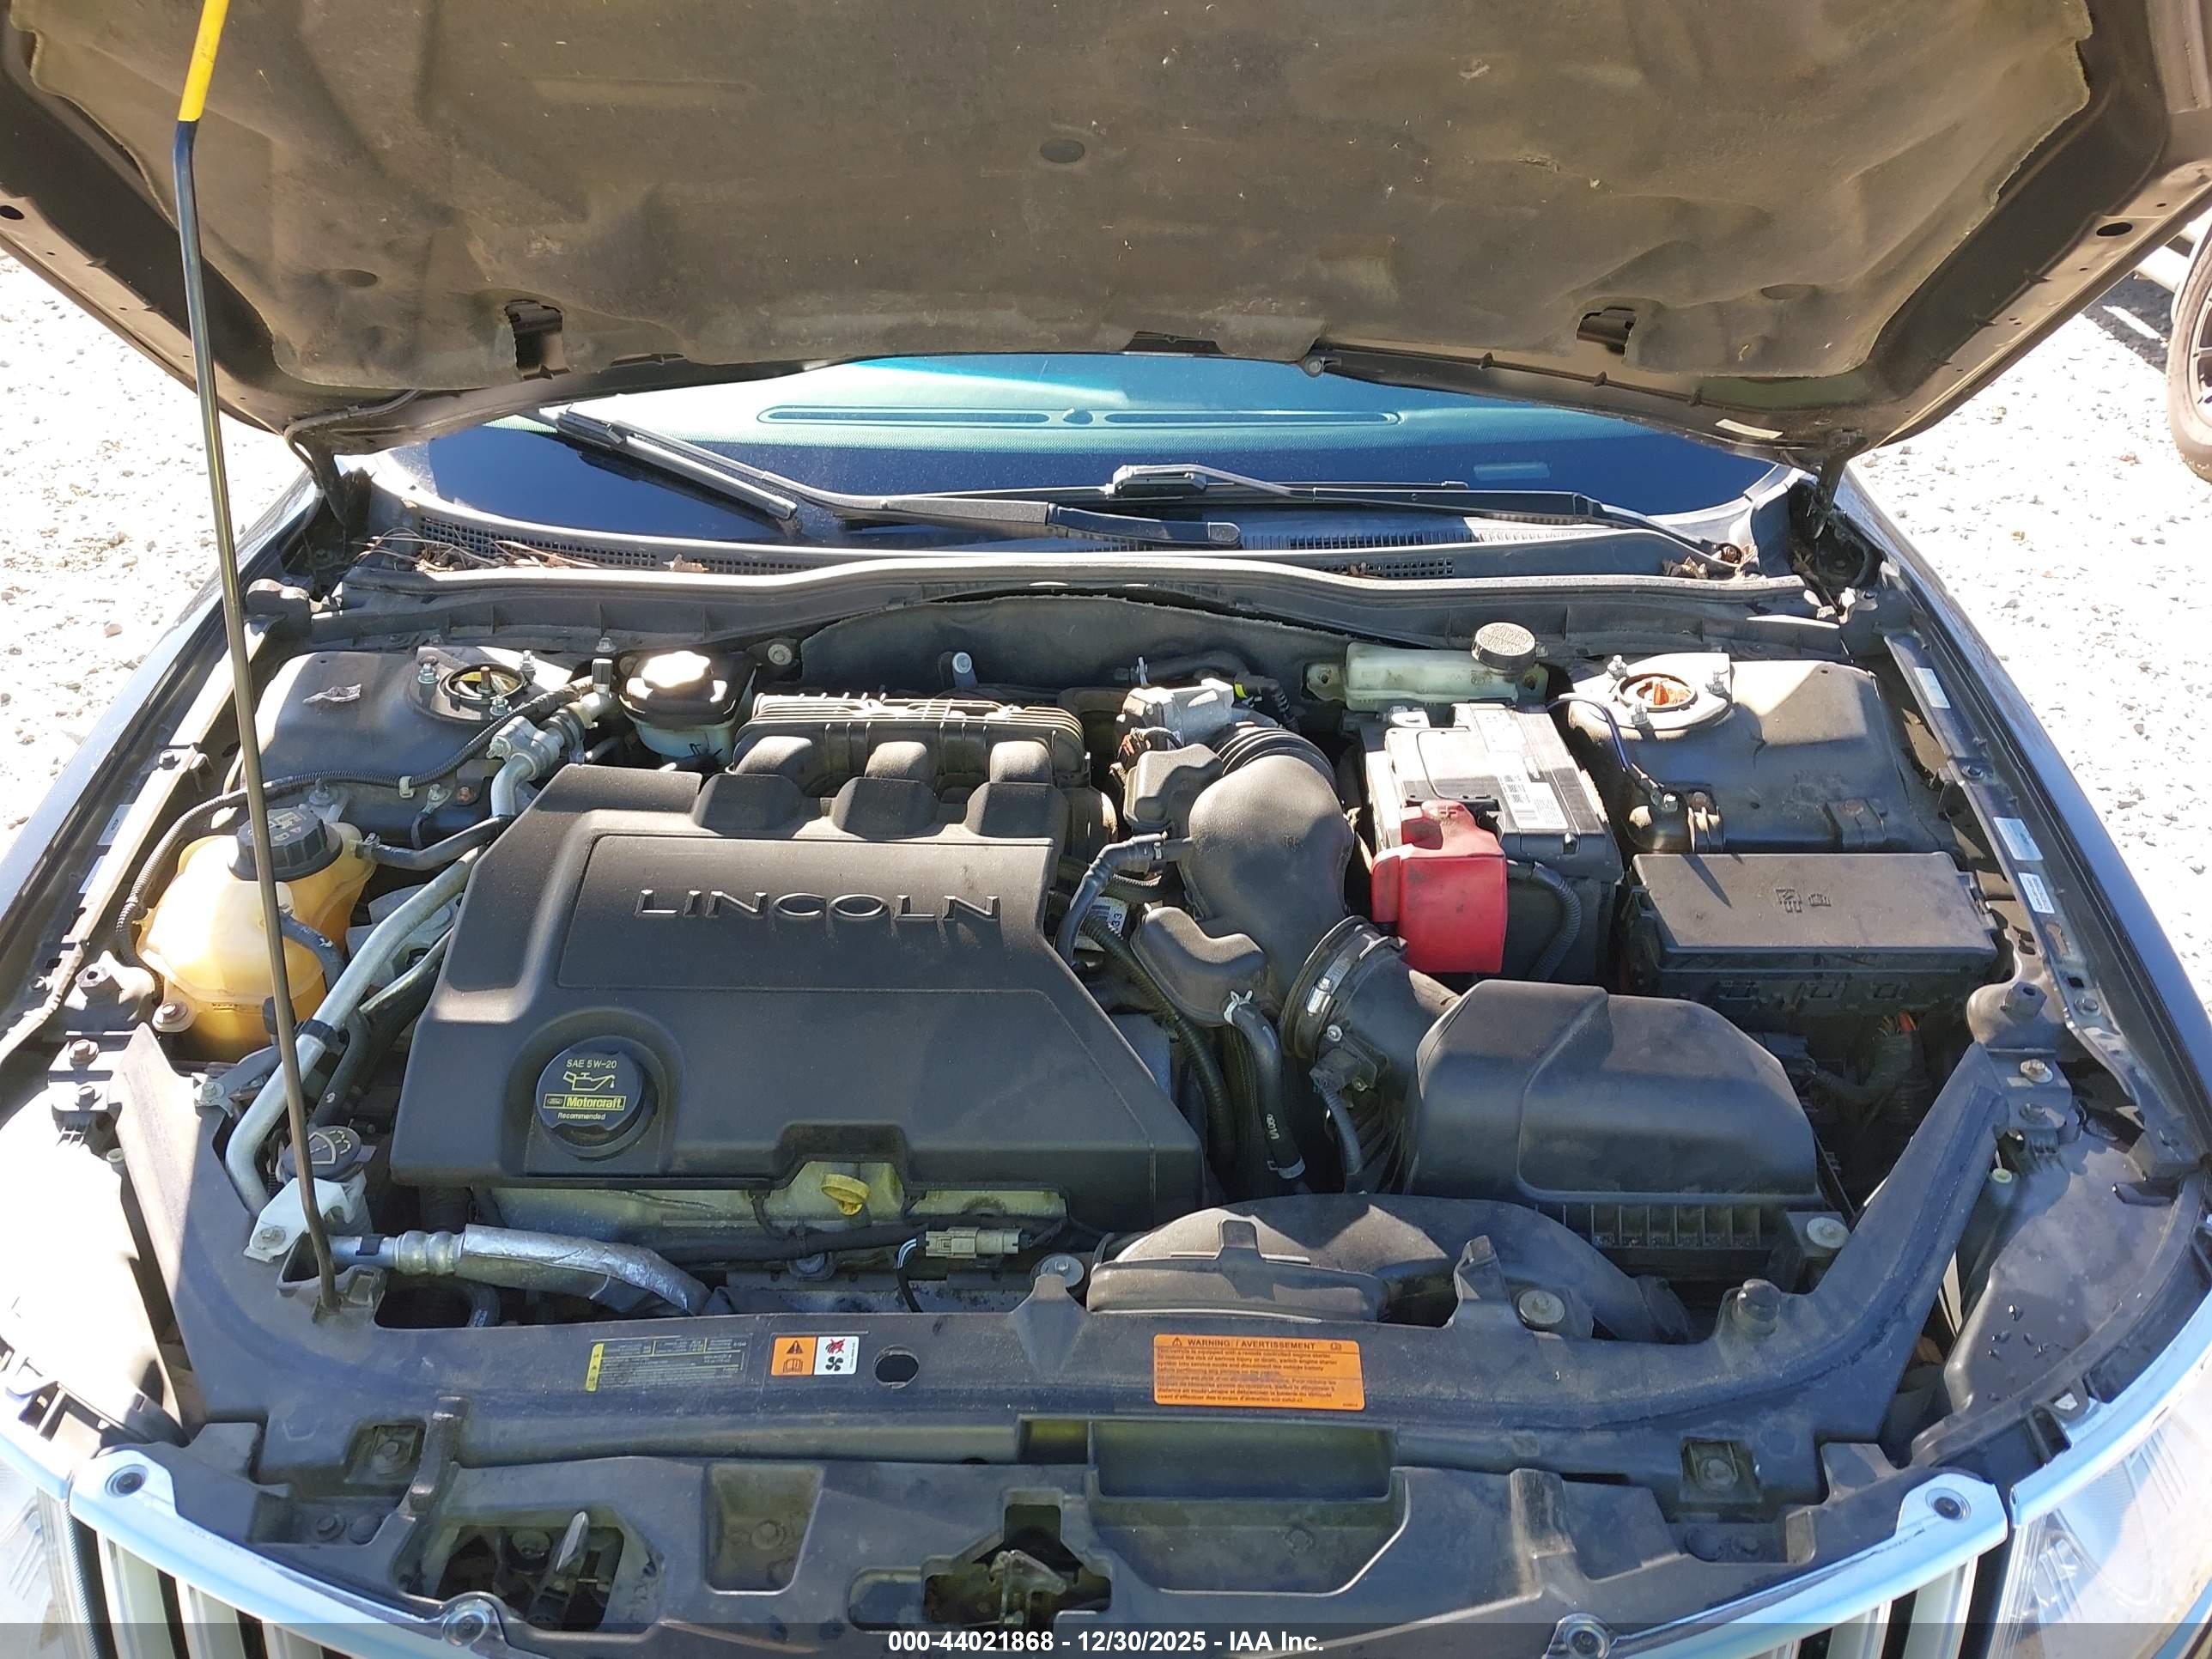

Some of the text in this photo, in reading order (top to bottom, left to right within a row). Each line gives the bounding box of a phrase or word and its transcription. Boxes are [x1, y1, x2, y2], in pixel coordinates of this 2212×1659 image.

[634, 890, 1000, 920] LINCOLN
[567, 1060, 617, 1069] SAE 5W-20
[567, 1097, 623, 1109] Motorcraft
[1242, 1340, 1316, 1350] AVERTISSEMENT
